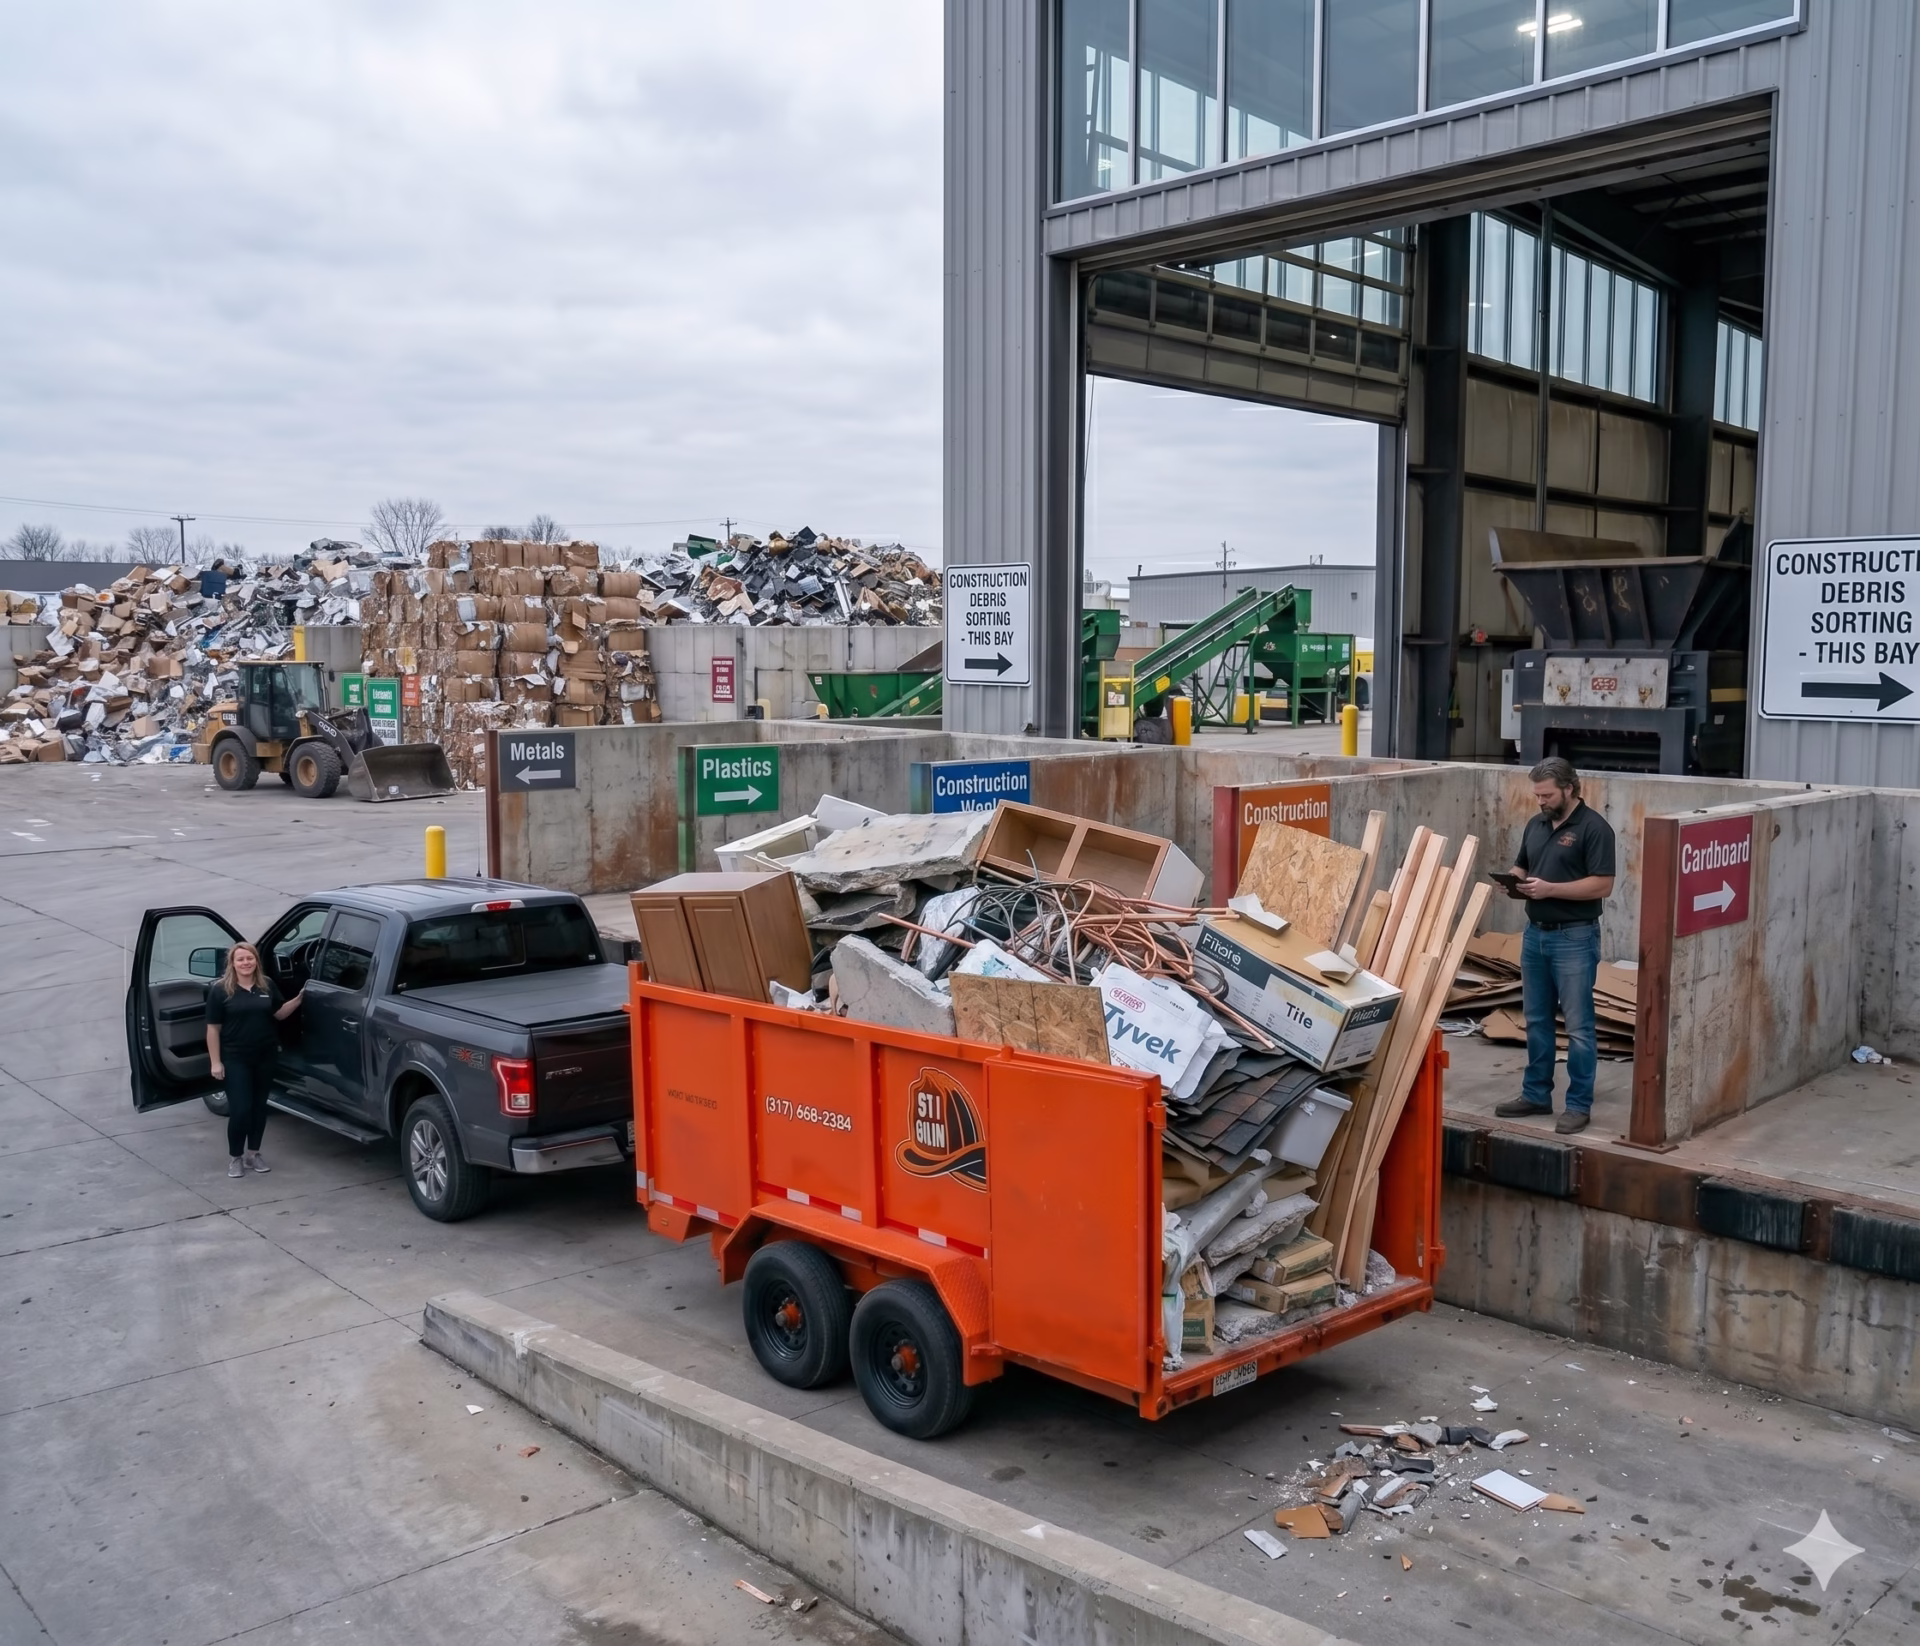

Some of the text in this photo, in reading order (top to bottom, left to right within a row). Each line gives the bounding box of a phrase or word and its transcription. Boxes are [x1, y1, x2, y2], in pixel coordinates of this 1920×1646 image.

[949, 571, 1027, 588] CONSTRUCTION
[970, 592, 1007, 607] DEBRIS
[1821, 581, 1906, 603] DEBRIS
[965, 611, 1011, 626] SORTING
[1811, 611, 1913, 634] SORTING
[968, 631, 991, 646] THIS
[994, 631, 1014, 646] BAY
[1815, 642, 1866, 664] THIS
[1874, 642, 1920, 664] BAY
[510, 741, 565, 761] Metals
[703, 757, 772, 779] Plastics
[936, 771, 1028, 797] Construction
[1244, 797, 1328, 826] Construction
[1681, 833, 1751, 875] Cardboard
[1286, 1001, 1313, 1029] Tile
[1105, 1001, 1182, 1065] Tyvek
[765, 1095, 852, 1132] (317) 668-2384
